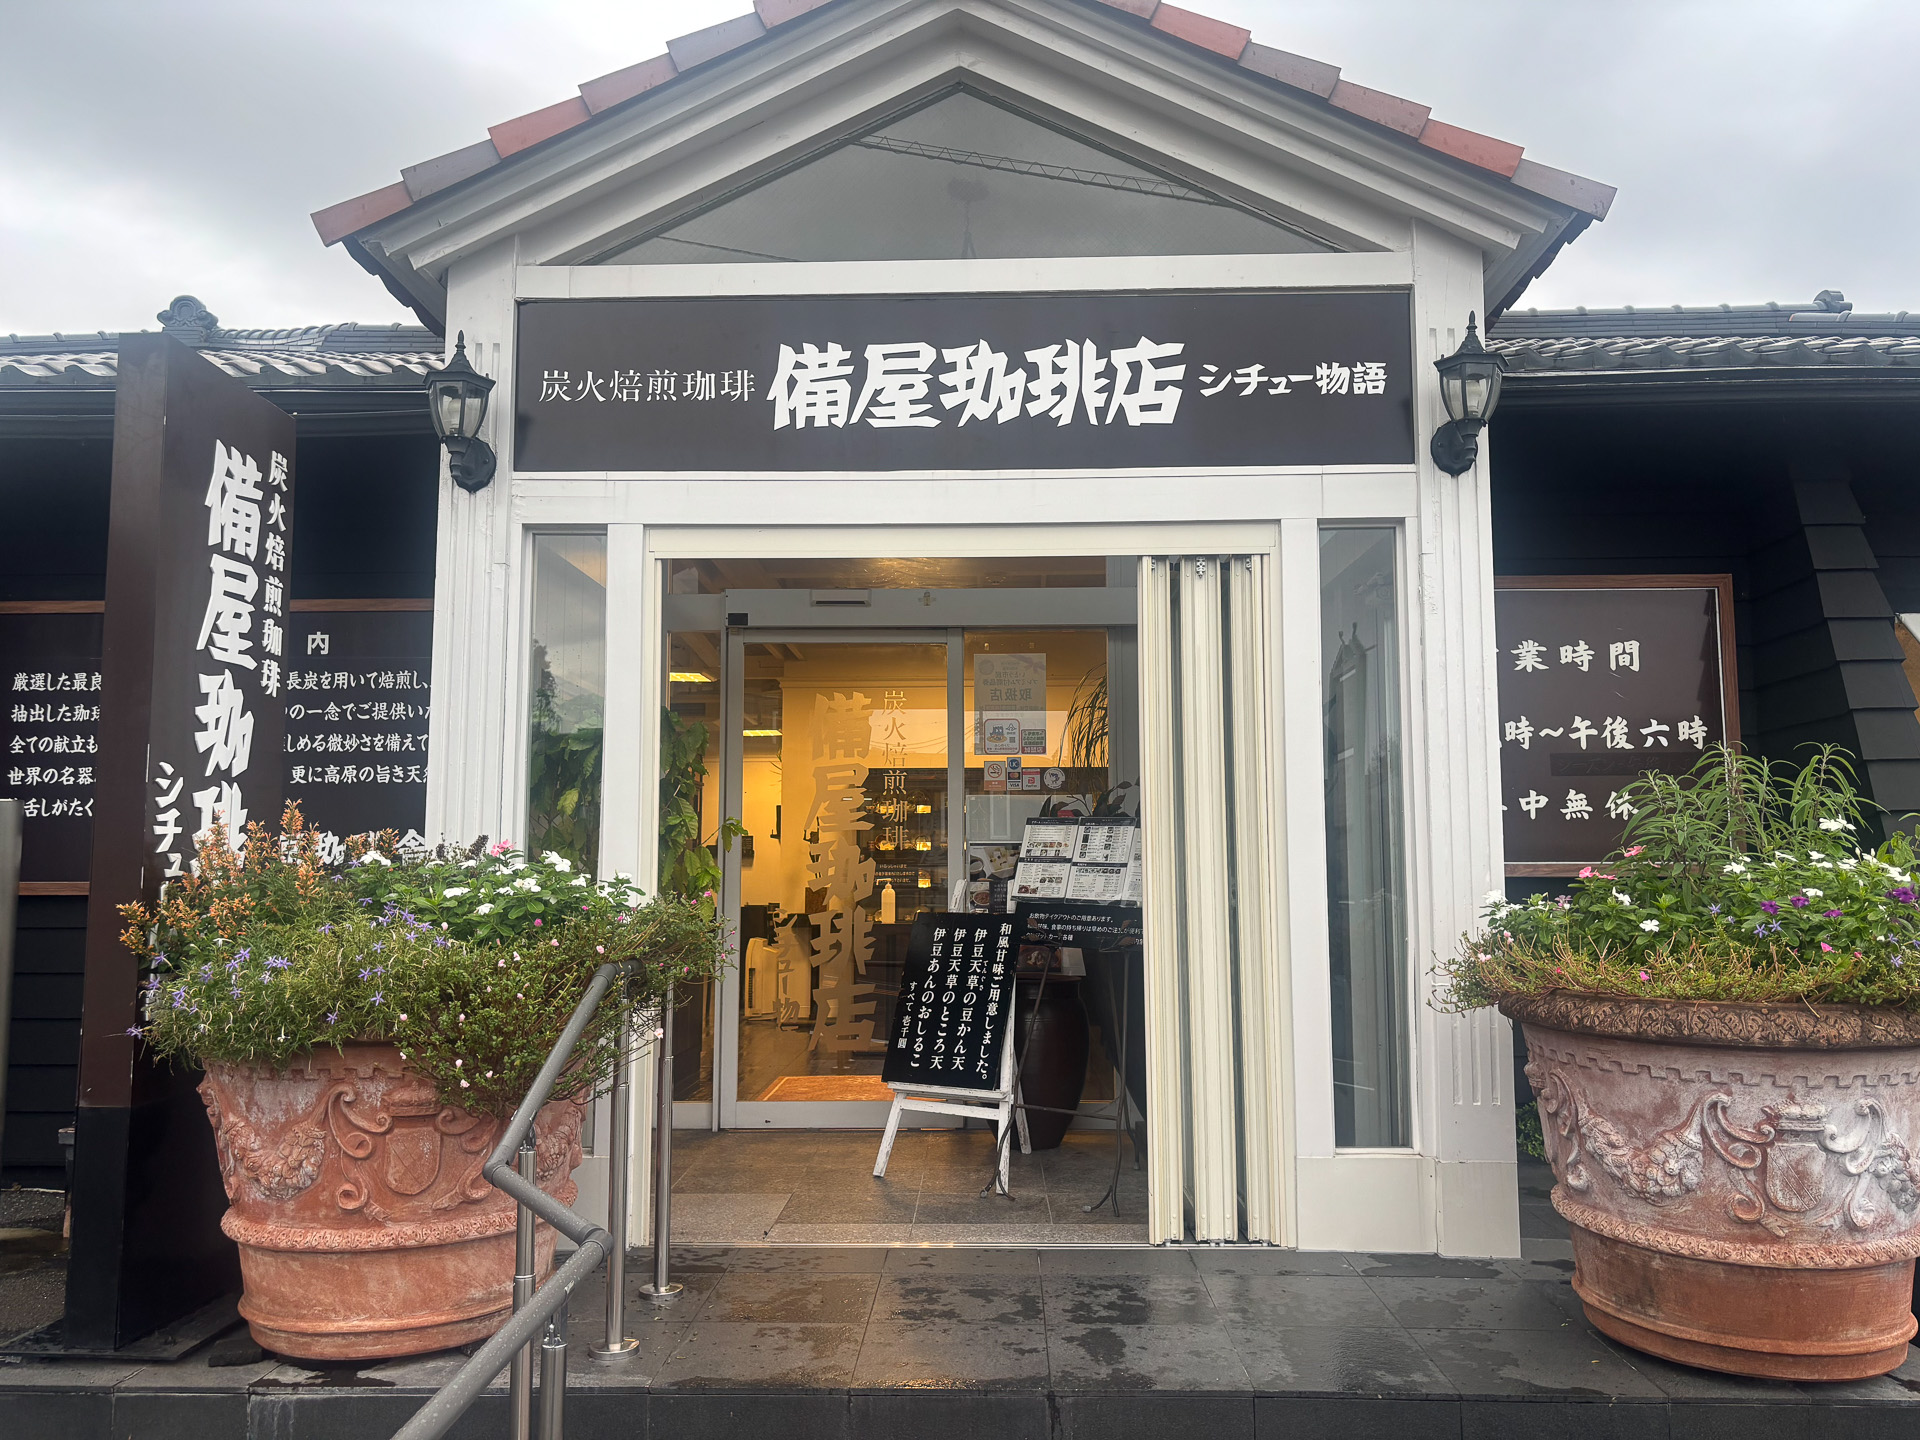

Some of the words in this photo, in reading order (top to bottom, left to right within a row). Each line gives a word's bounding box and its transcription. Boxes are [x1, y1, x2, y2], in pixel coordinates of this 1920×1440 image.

[539, 369, 755, 402] 炭火焙煎珈琲
[766, 337, 1187, 430] 備屋珈琲店
[1198, 361, 1388, 398] シチュー物語
[260, 450, 288, 698] 炭火焙煎珈琲
[307, 631, 330, 655] 内
[1495, 639, 1641, 673] 業時間
[286, 670, 432, 691] 長炭を用いて焙煎し、
[284, 702, 431, 721] の一念でご提供い
[284, 733, 430, 753] しめる微妙さを備えて
[1500, 715, 1709, 751] 時～午後六時
[7, 766, 97, 786] 世界の名器
[881, 690, 908, 851] 炭火焙煎珈琲
[9, 798, 94, 818] 舌しがたく
[1502, 789, 1639, 821] 中無休
[804, 691, 877, 1051] 備屋珈琲店
[910, 927, 947, 1068] 伊豆あんのおしるこ
[929, 927, 967, 1070] 伊豆天草のところ天
[951, 928, 988, 1071] 伊豆天草の豆かん天
[976, 922, 1012, 1080] 和風甘味ご用意しました。
